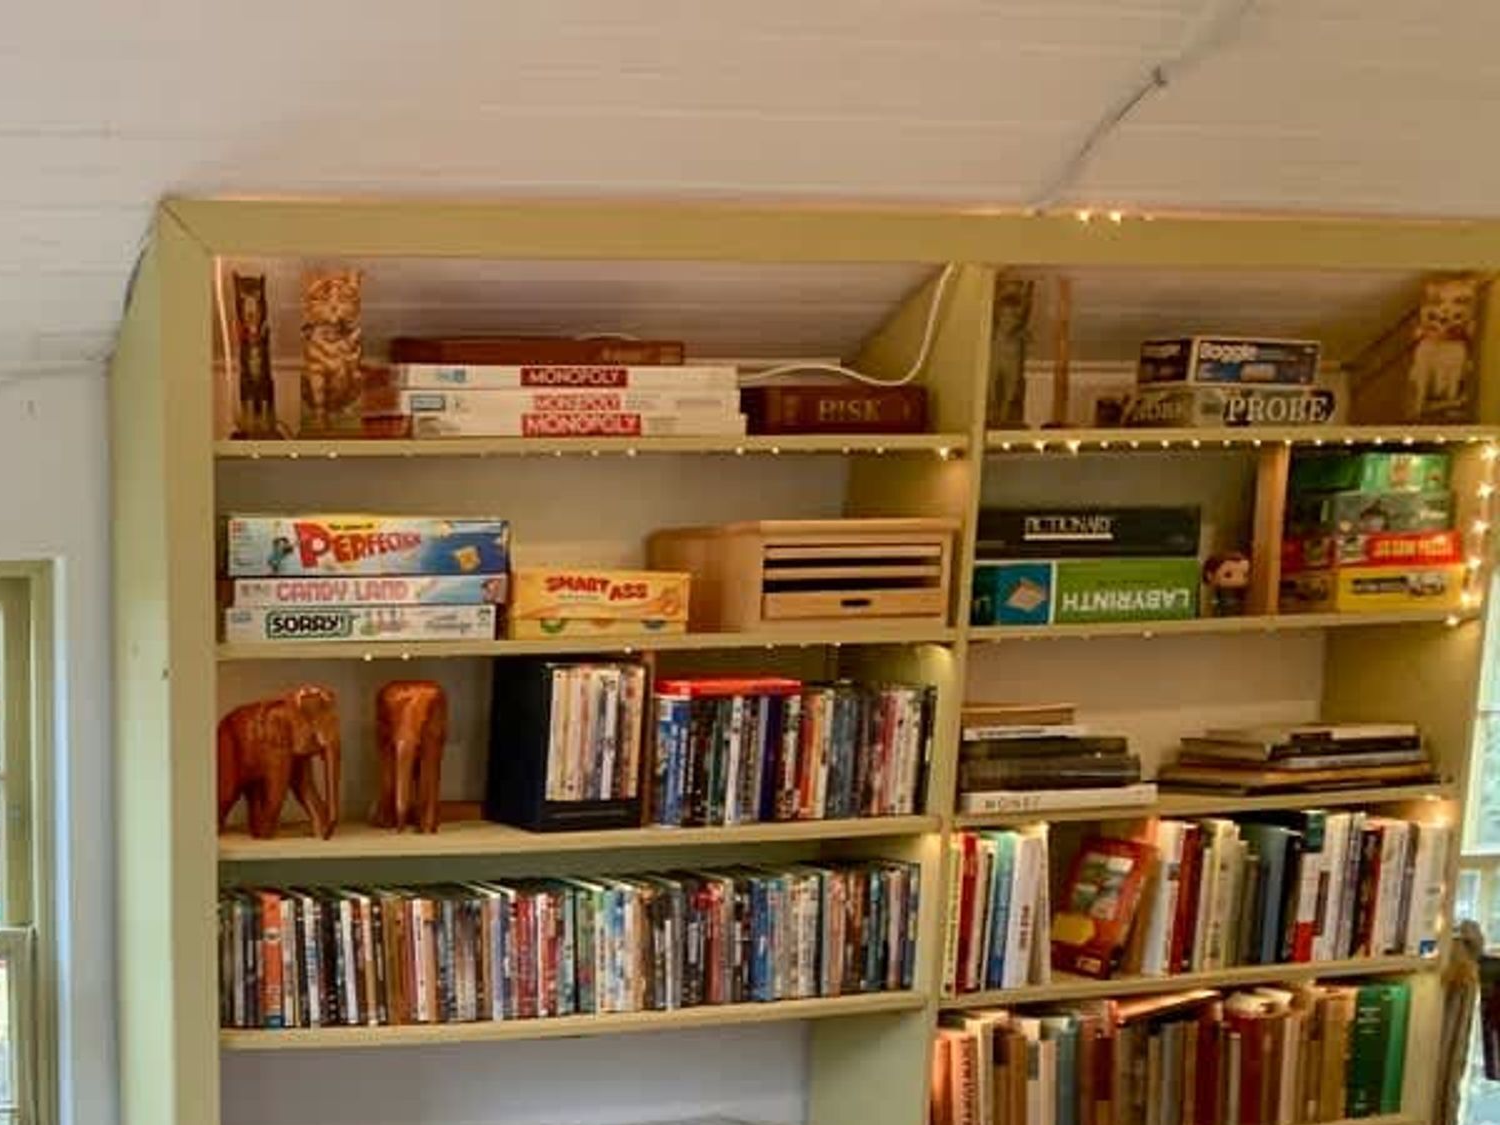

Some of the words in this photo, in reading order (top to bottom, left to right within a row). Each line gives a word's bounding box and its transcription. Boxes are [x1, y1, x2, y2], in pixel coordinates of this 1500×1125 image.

[529, 368, 619, 386] MONOPOLY
[534, 395, 621, 411] MONOPOLY
[819, 399, 882, 422] RISK
[1226, 396, 1327, 422] PROBE
[525, 416, 636, 435] MONOPOLY
[275, 580, 348, 601] CANDY
[354, 579, 409, 600] LAND
[545, 575, 609, 593] SMART
[608, 582, 648, 600] ASS
[1062, 588, 1190, 611] LABYRINTH
